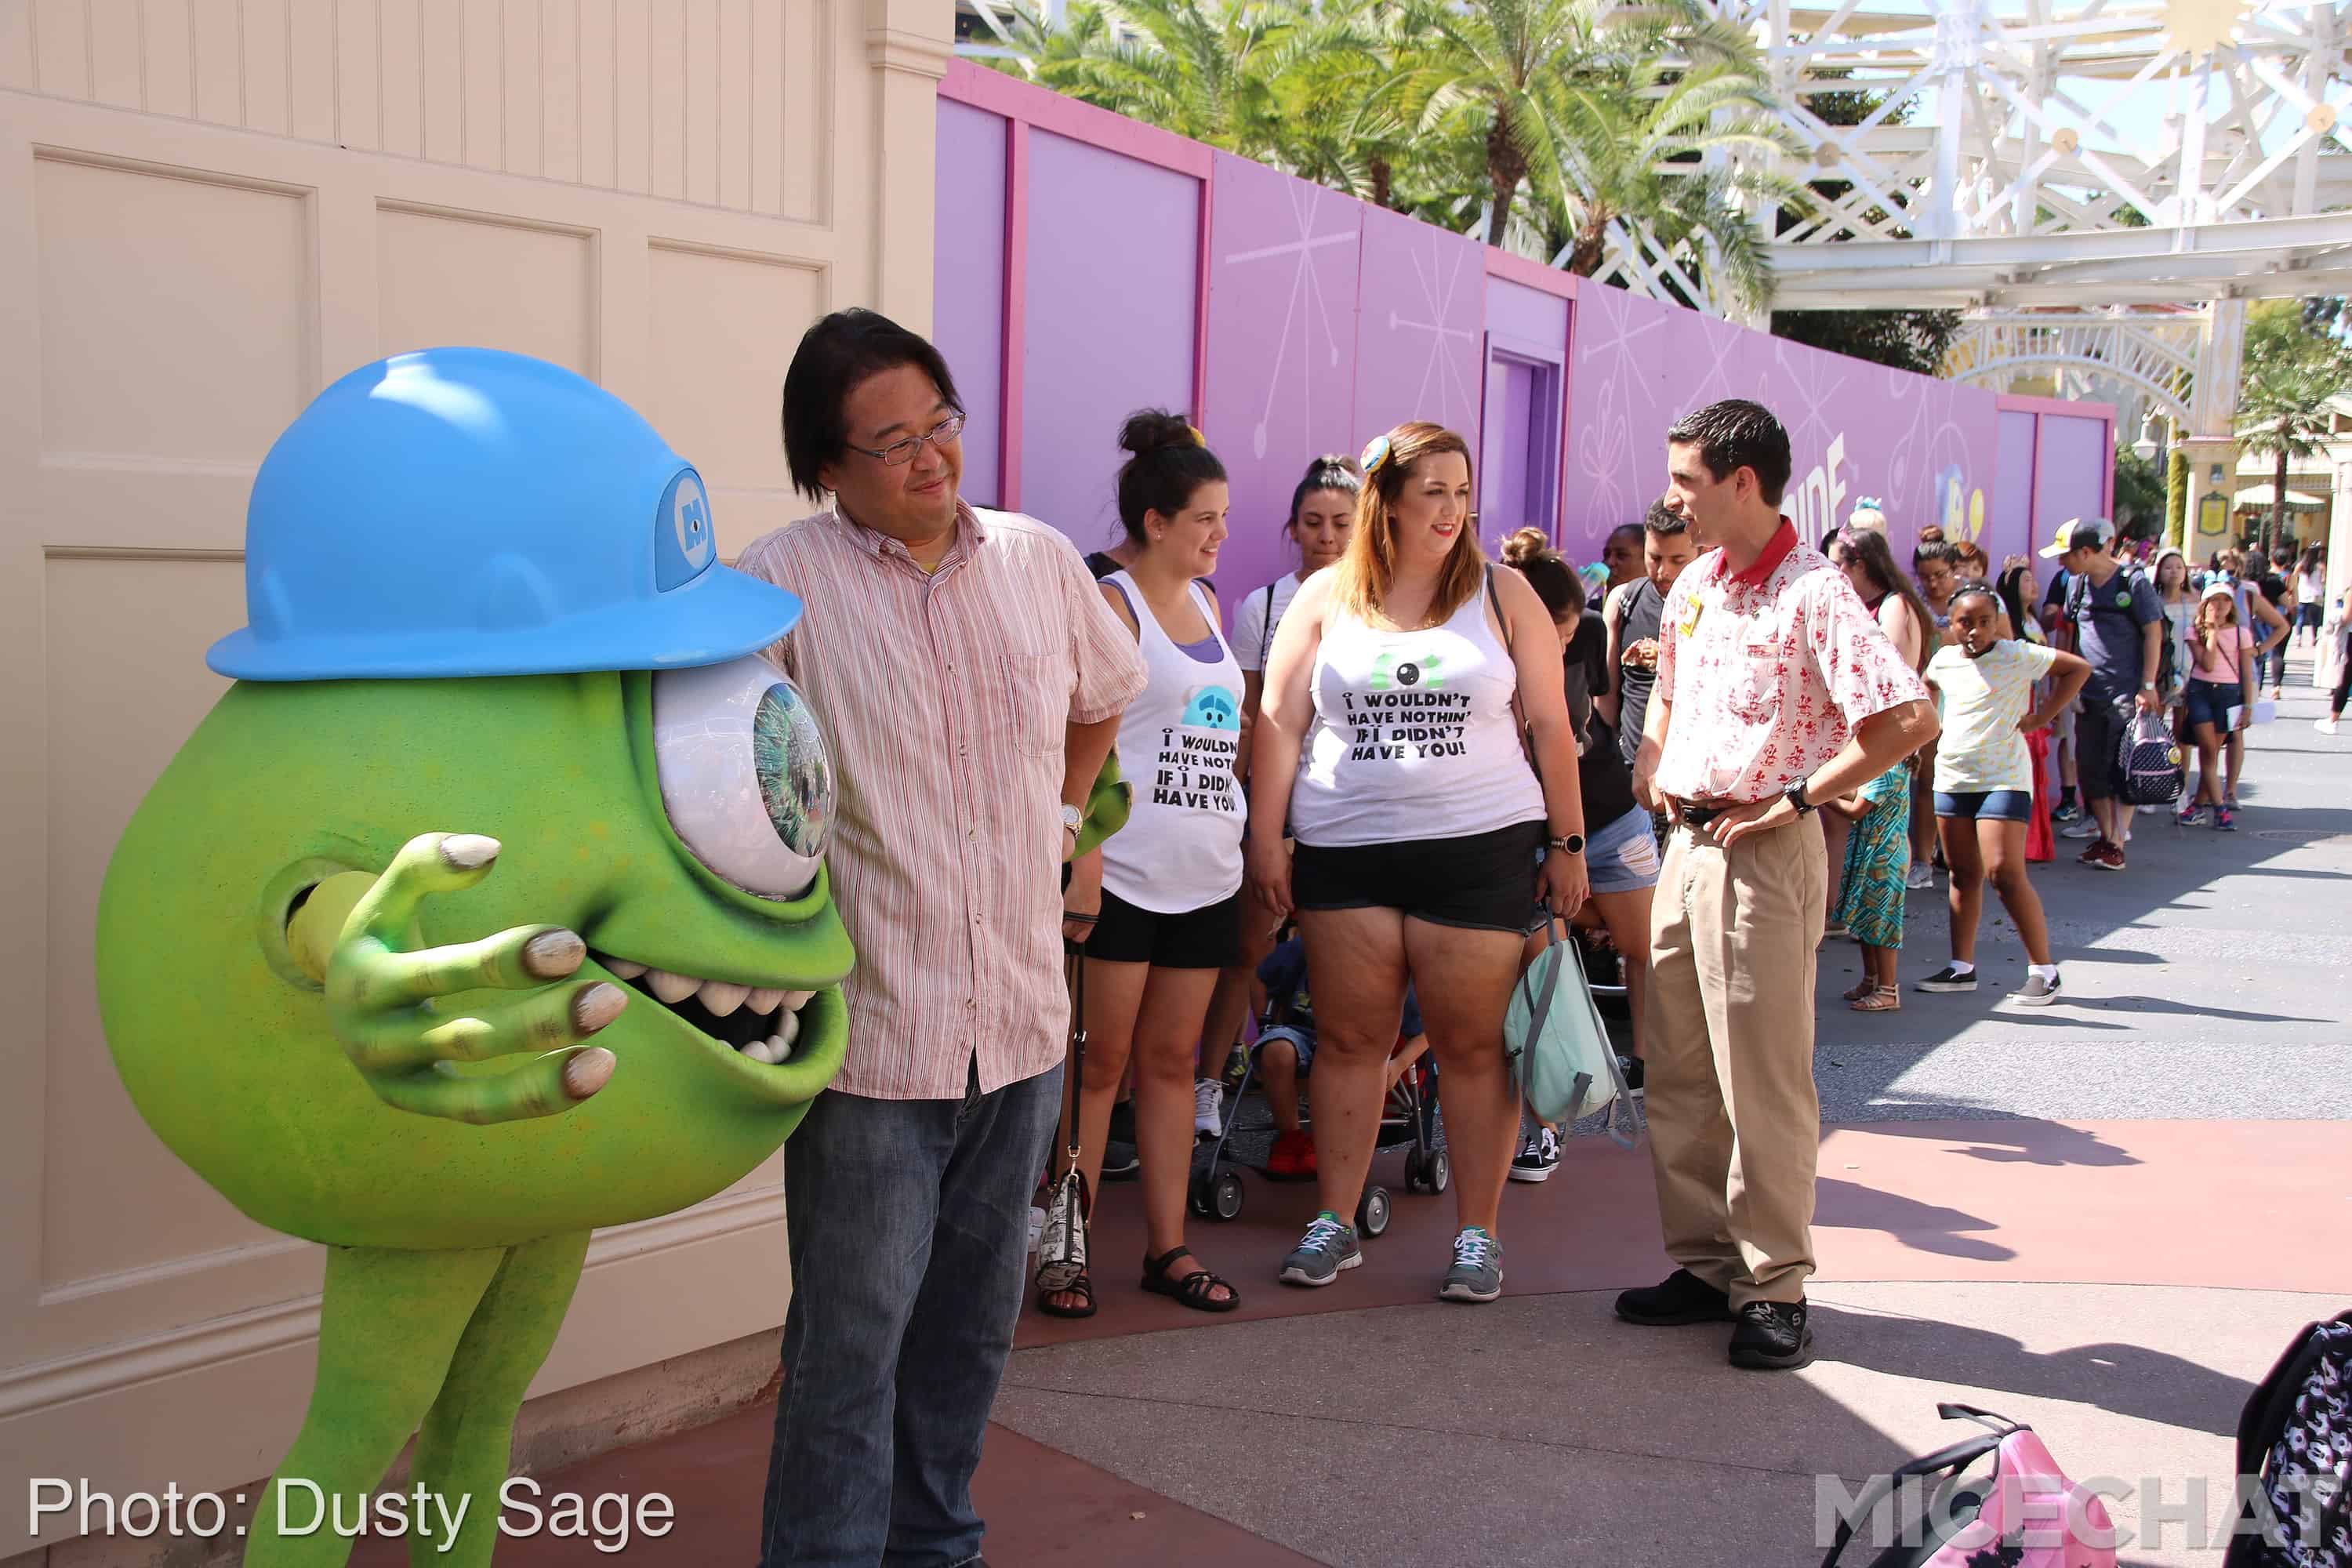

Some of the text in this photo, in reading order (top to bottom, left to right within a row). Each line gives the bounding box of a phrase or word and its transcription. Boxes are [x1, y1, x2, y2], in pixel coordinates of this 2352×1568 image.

[1780, 430, 1846, 550] IDE
[1364, 693, 1470, 707] WOULDN'T
[1348, 711, 1471, 725] HAVE NOTHIN'
[1392, 726, 1465, 742] DIDN'T
[1352, 742, 1466, 760] HAVE YOU!
[1159, 751, 1234, 769] HAVE NOT
[1157, 770, 1173, 786] IF
[1153, 788, 1208, 809] HAVE
